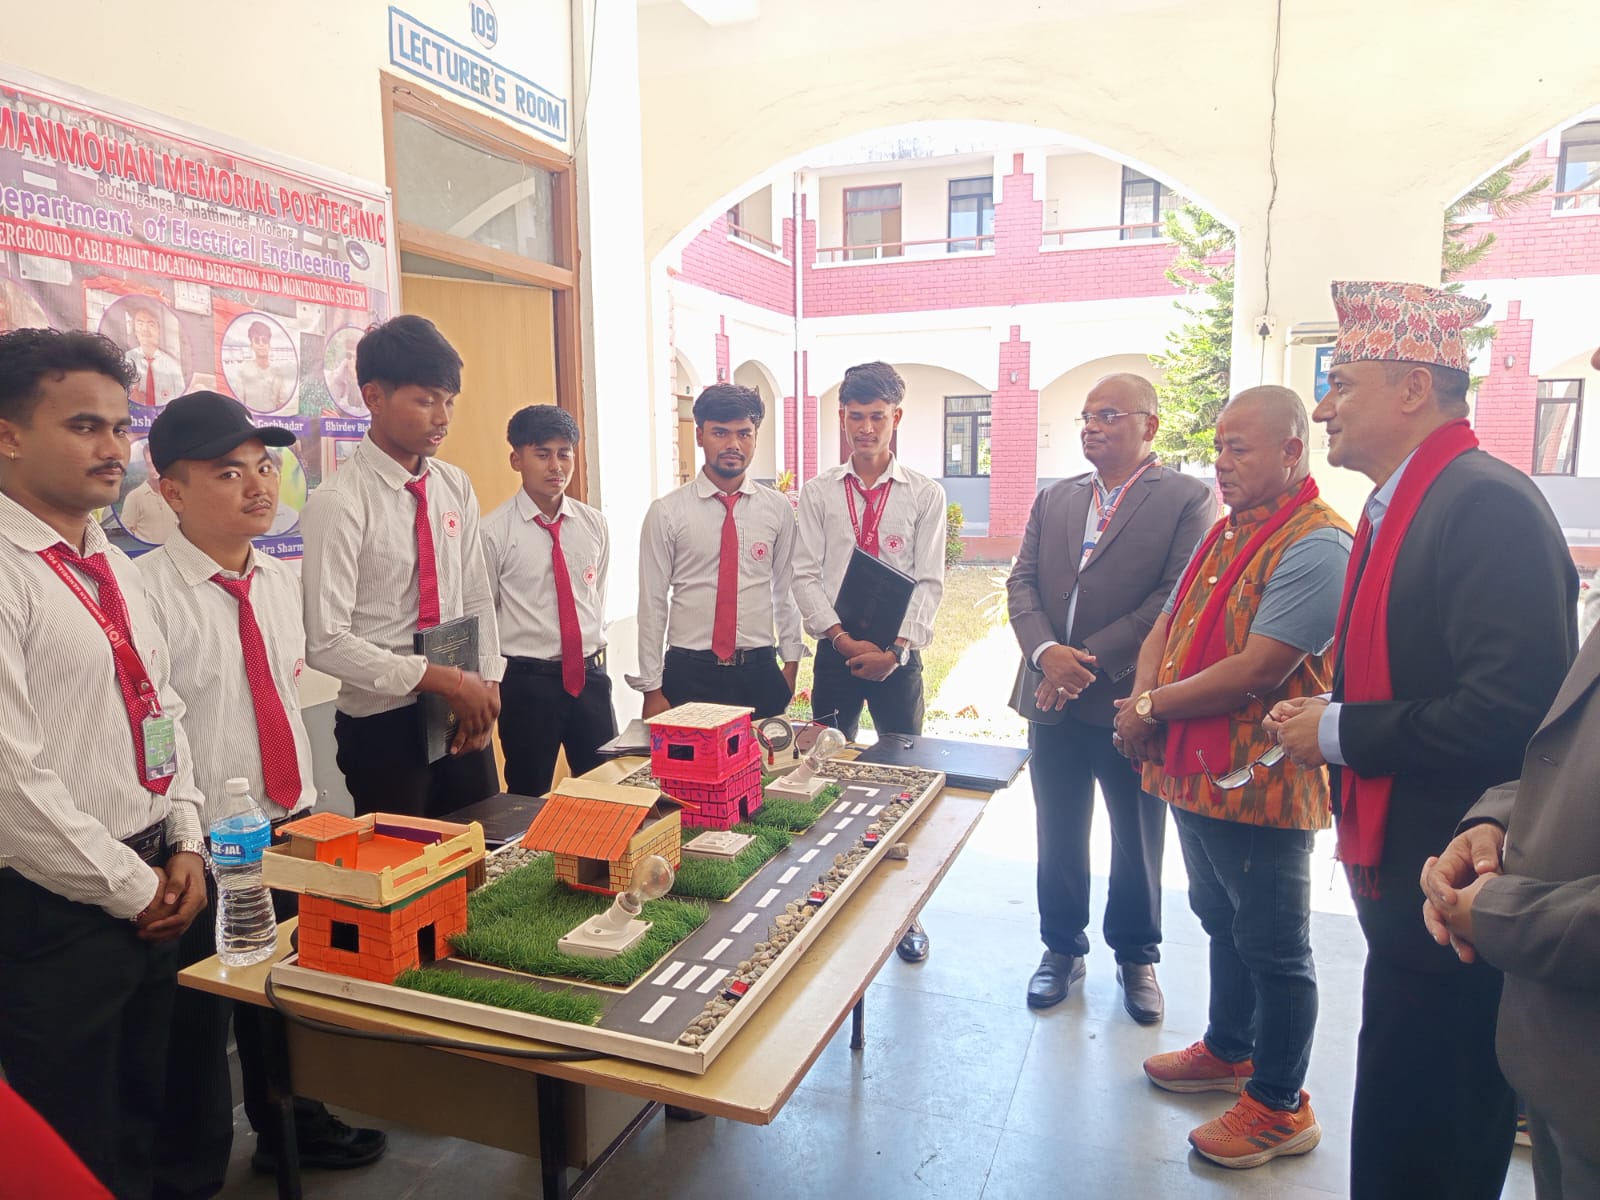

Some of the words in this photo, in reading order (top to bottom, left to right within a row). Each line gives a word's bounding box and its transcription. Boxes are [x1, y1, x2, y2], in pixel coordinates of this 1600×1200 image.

[471, 3, 497, 44] 109
[398, 23, 506, 104] LECTURER'S
[515, 84, 560, 130] ROOM
[0, 183, 133, 236] epartment
[144, 215, 166, 242] of
[172, 219, 255, 260] Electrical
[261, 239, 351, 284] Engineering
[162, 153, 277, 217] MEMORIAL
[279, 186, 386, 245] POLYTECHNIC
[75, 237, 114, 265] CABLE
[116, 244, 150, 271] FAULT
[152, 252, 204, 280] LOCATION
[206, 261, 260, 289] DERECTION
[261, 273, 281, 294] AND
[282, 277, 335, 301] MONITORING
[335, 288, 367, 308] SYSTEM
[277, 542, 304, 554] Sharm
